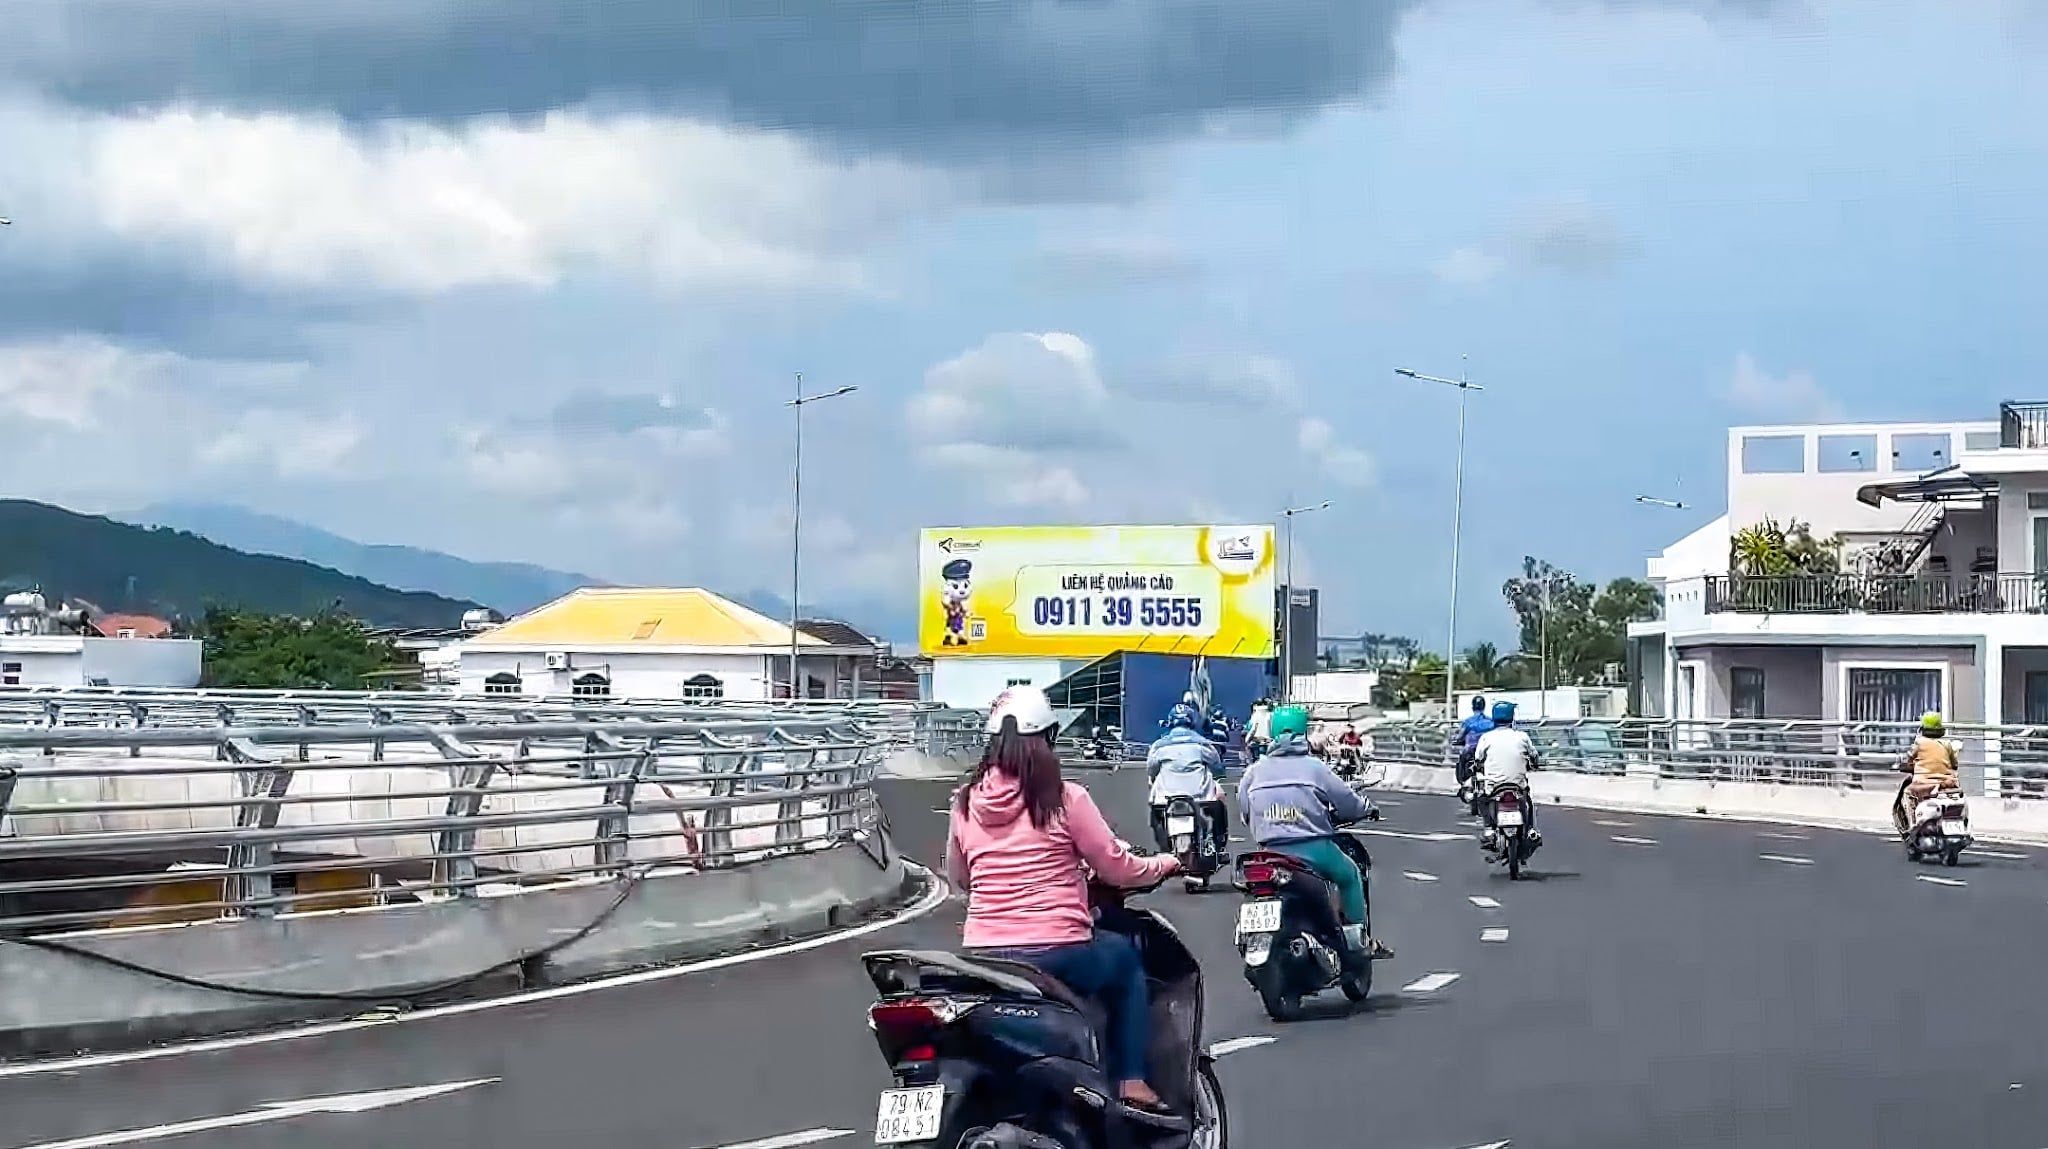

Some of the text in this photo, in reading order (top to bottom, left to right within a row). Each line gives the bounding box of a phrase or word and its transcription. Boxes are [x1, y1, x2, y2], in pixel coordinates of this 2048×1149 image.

[1062, 573, 1088, 591] LIÊN
[1034, 597, 1202, 627] 0911 39 5555
